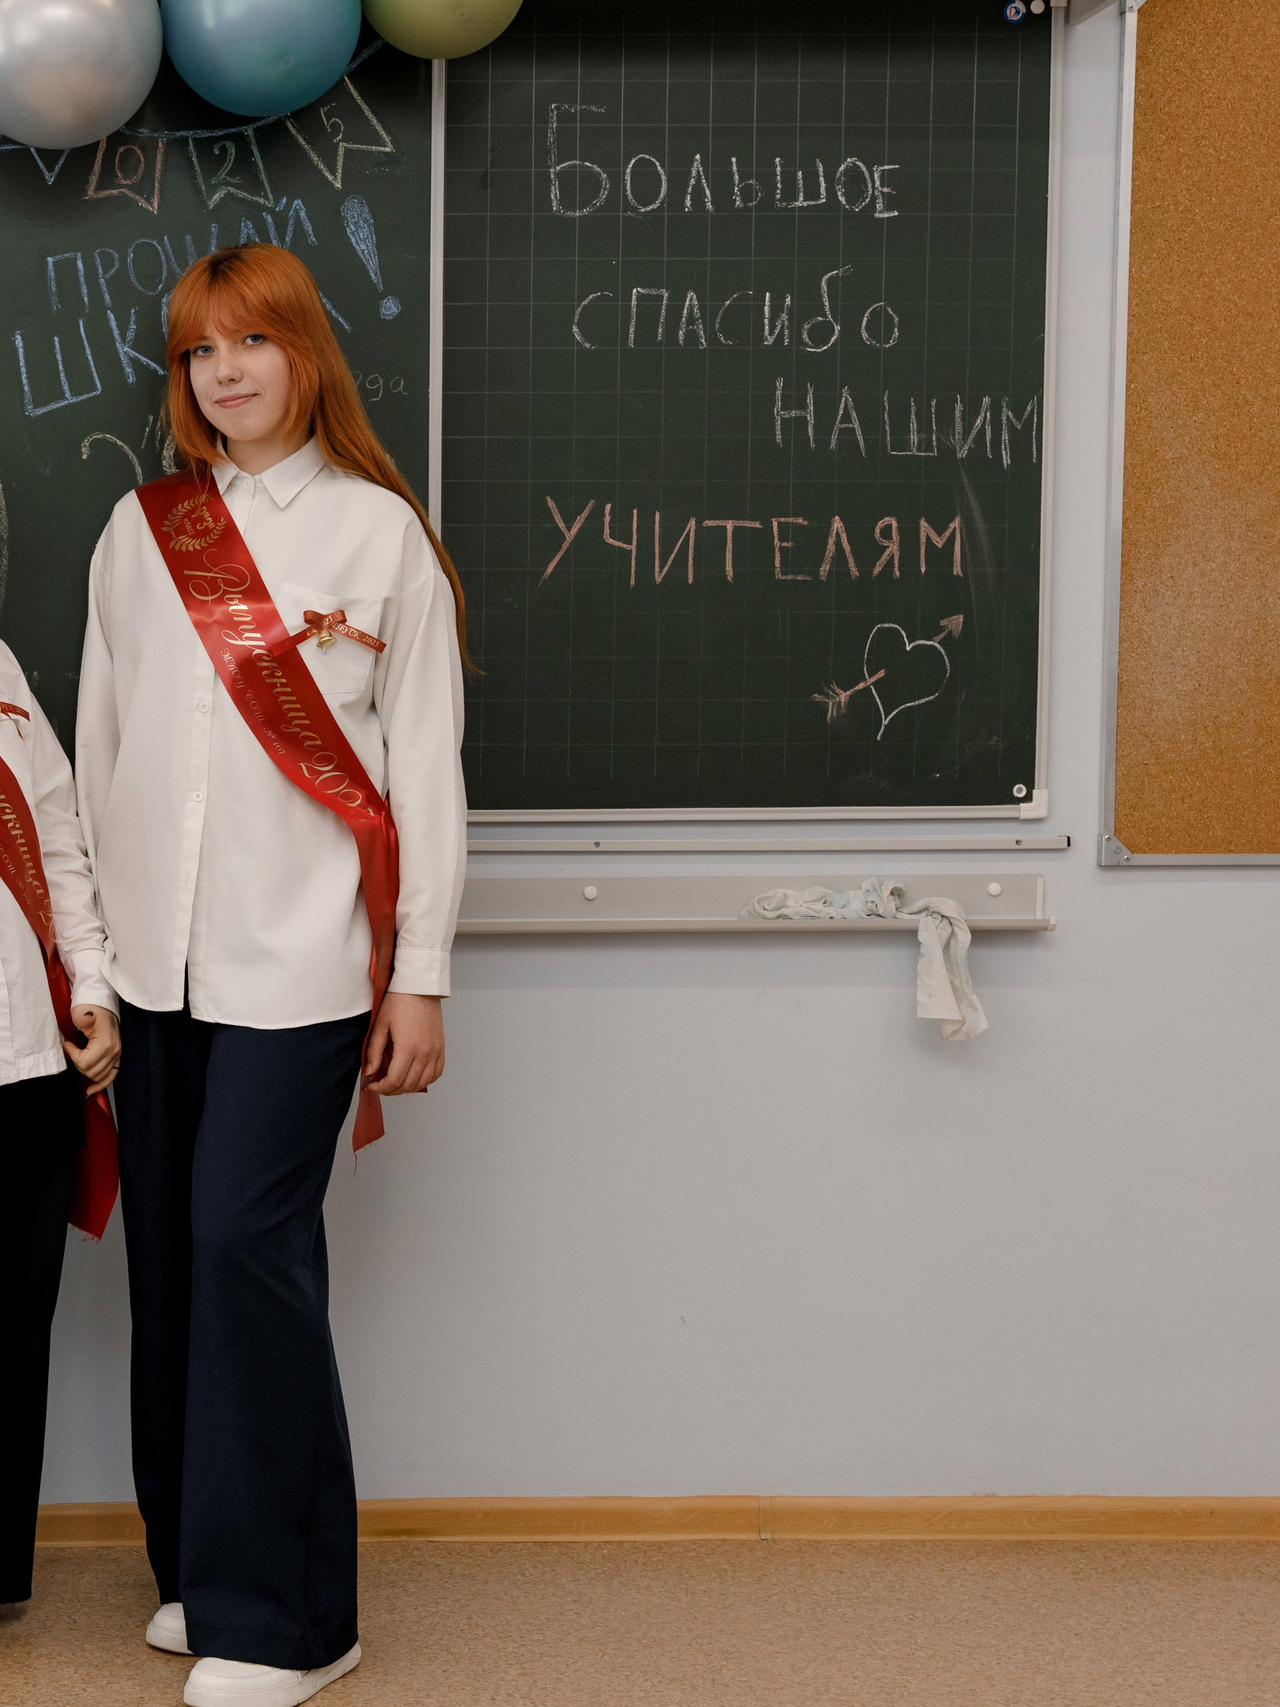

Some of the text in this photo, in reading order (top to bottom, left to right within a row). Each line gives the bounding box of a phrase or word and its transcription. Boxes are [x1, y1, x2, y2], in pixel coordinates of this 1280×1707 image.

[114, 102, 345, 185] 025
[773, 376, 1038, 470] НАШИМ
[538, 495, 964, 589] УЧИТЕЛЯМ
[183, 548, 323, 750] Выпускница
